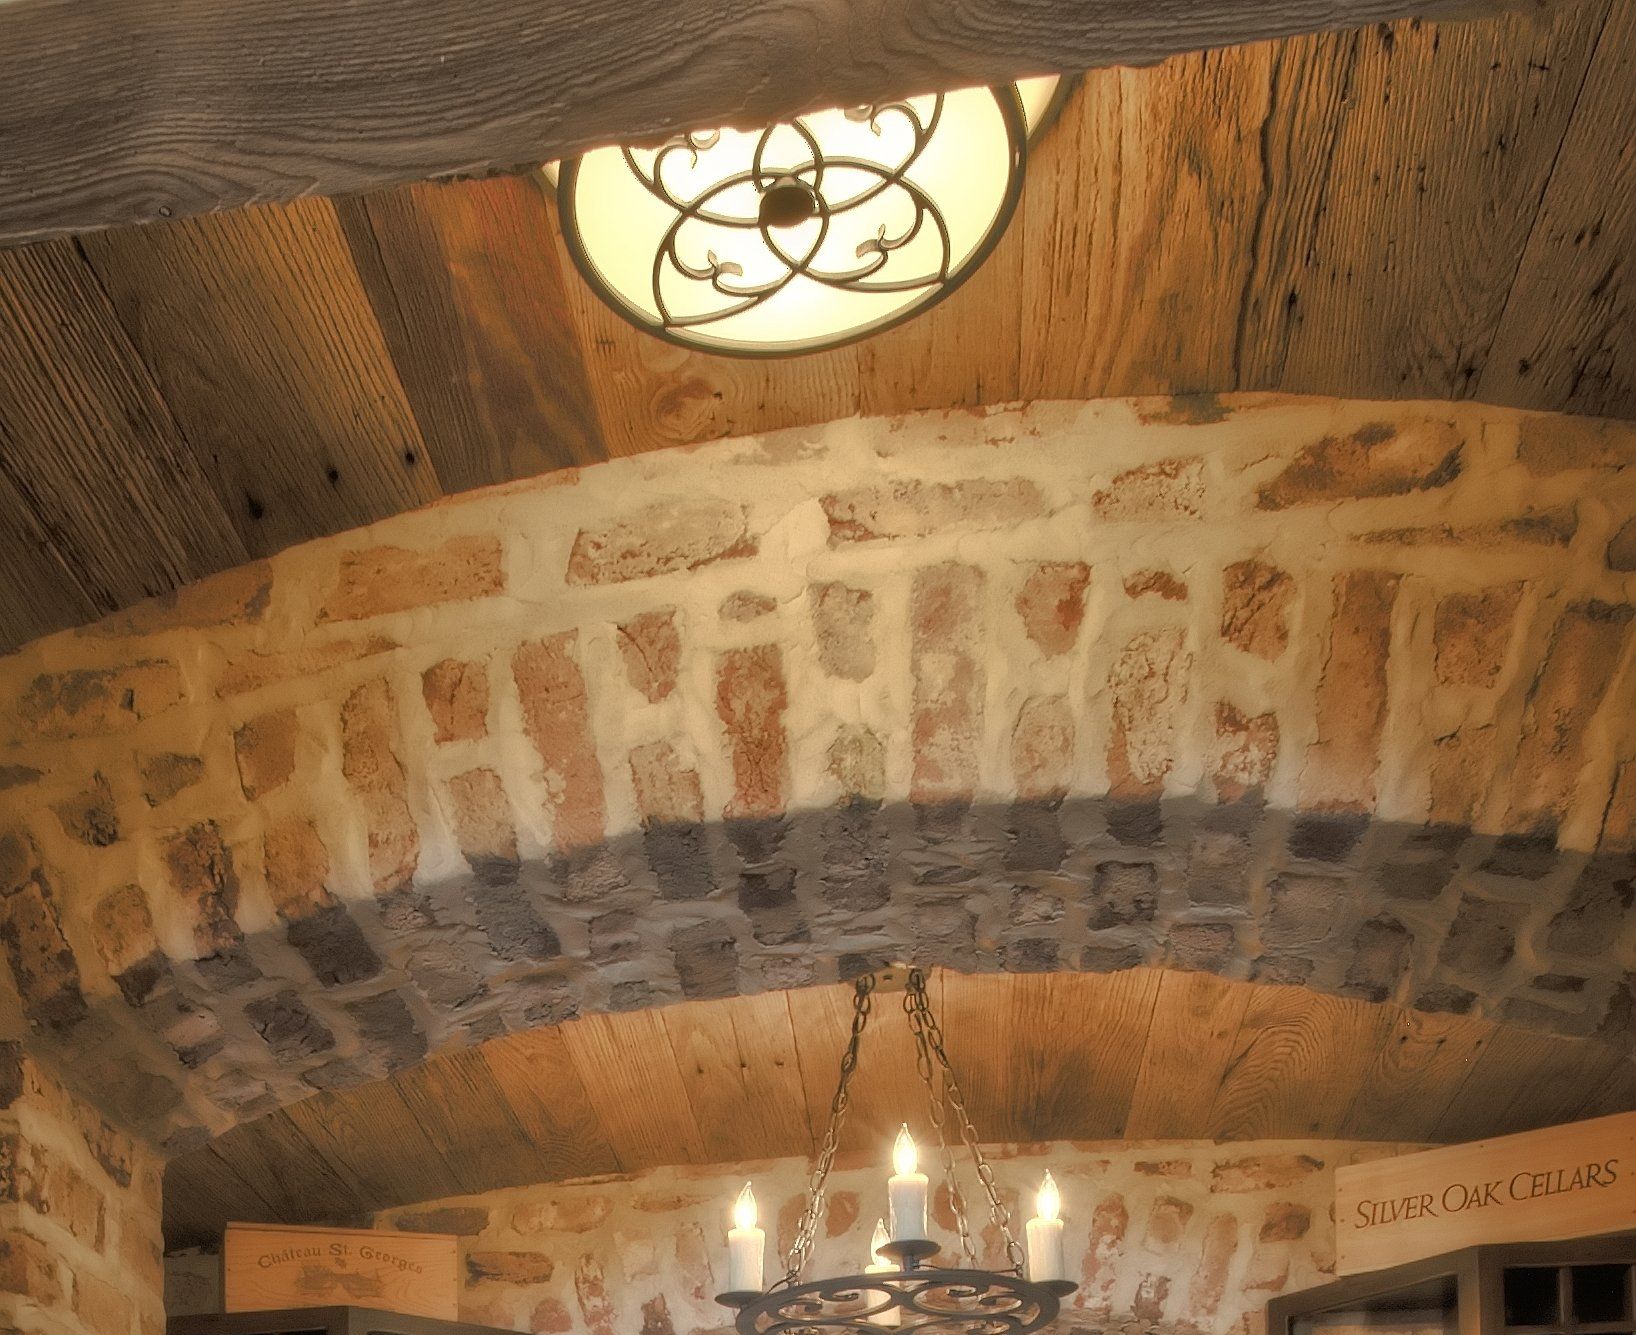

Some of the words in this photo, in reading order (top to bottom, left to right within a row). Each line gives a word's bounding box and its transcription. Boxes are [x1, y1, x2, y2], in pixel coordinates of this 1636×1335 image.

[1354, 1193, 1439, 1229] SILVER
[1441, 1180, 1504, 1213] OAK
[1509, 1158, 1619, 1202] CELLARS
[359, 1245, 423, 1274] Georges
